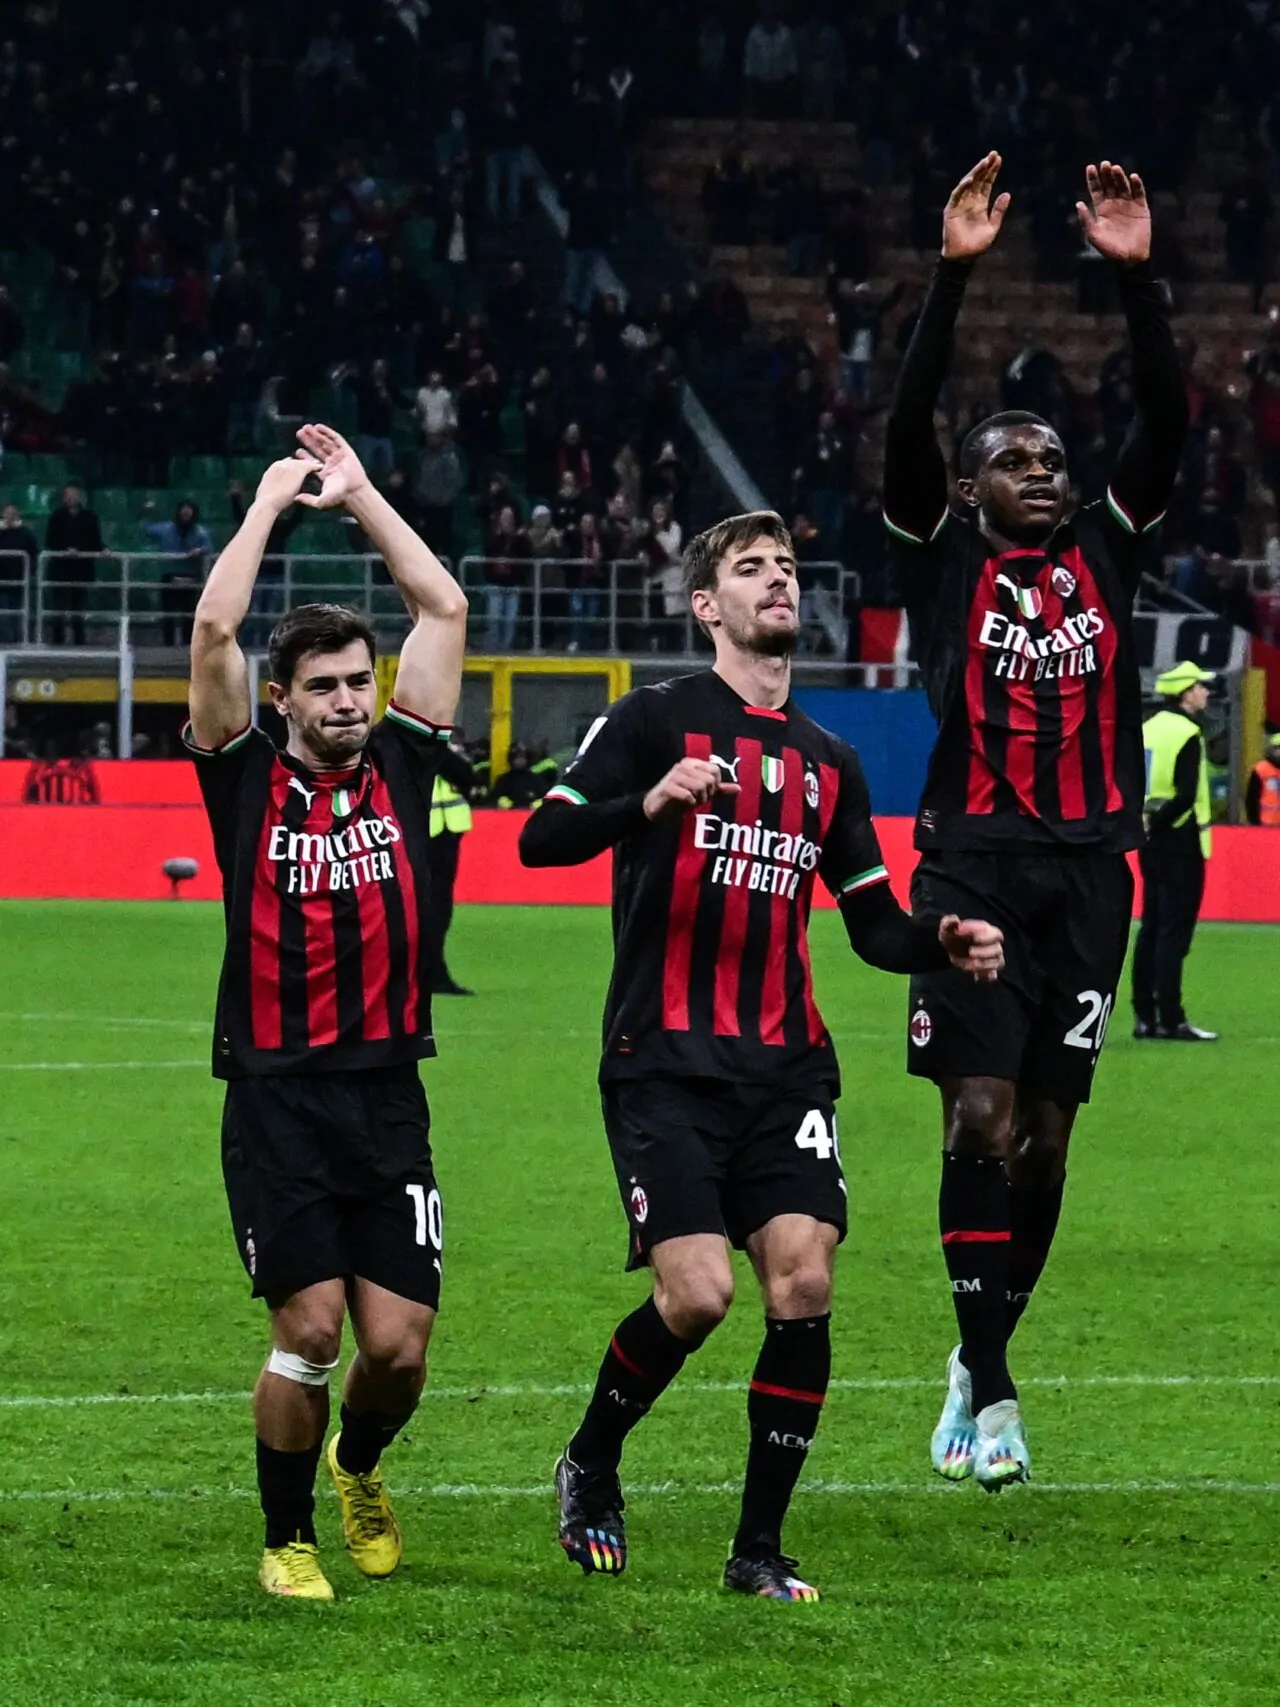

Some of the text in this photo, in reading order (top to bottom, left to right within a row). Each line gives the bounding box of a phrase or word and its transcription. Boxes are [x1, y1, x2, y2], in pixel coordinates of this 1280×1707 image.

[995, 644, 1096, 681] FLY BETTER
[267, 815, 401, 863] Emirates
[694, 813, 822, 872] Emirates
[287, 851, 395, 894] FLY BETTER
[711, 856, 748, 887] FLY
[1063, 989, 1112, 1050] 20
[794, 1108, 841, 1168] 4
[405, 1183, 443, 1251] 10
